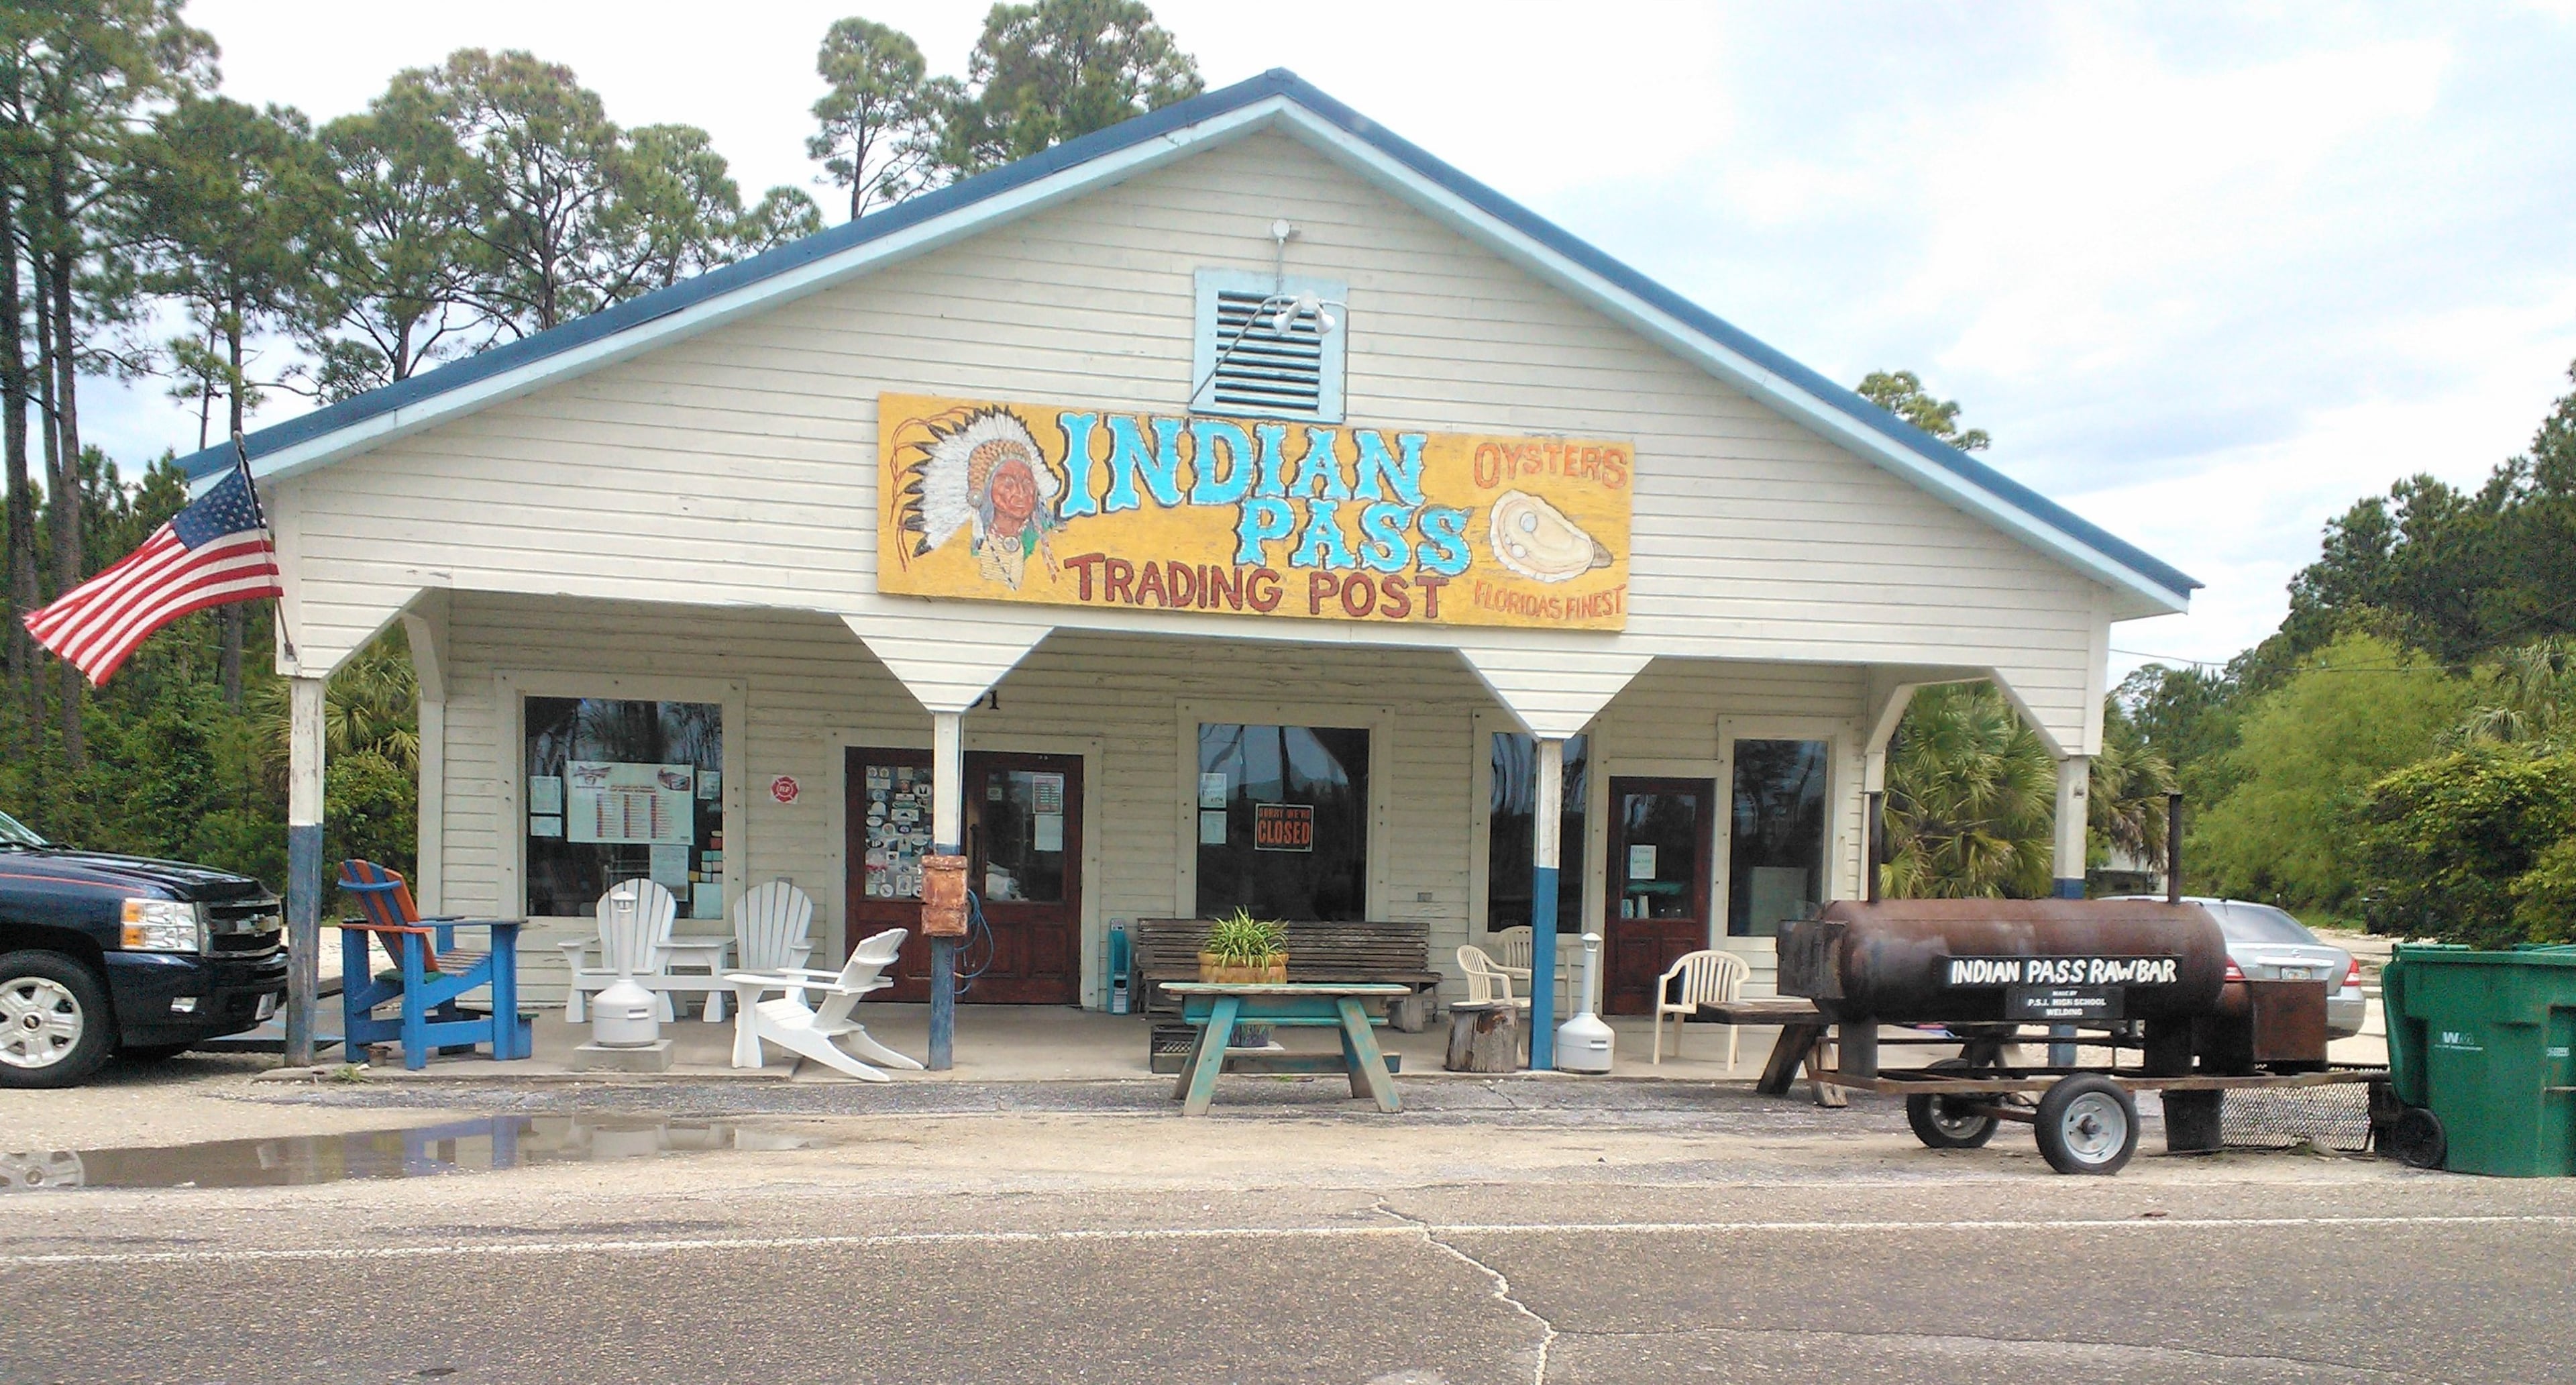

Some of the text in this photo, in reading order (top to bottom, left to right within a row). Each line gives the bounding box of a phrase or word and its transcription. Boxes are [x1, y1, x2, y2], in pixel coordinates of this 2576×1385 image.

[1055, 411, 1428, 520] INDIAN
[1474, 442, 1628, 489] OYSTERS
[1232, 496, 1474, 577] PASS
[1063, 552, 1449, 619] TRADING POST
[1474, 579, 1626, 619] FLORIDAS FINEST
[1257, 820, 1311, 844] CLOSED
[1951, 960, 2021, 984] INDIAN
[2027, 960, 2087, 984] PASS
[2046, 1008, 2084, 1017] WELDING
[2053, 998, 2073, 1007] HIGH
[2074, 998, 2107, 1007] SCHOOL
